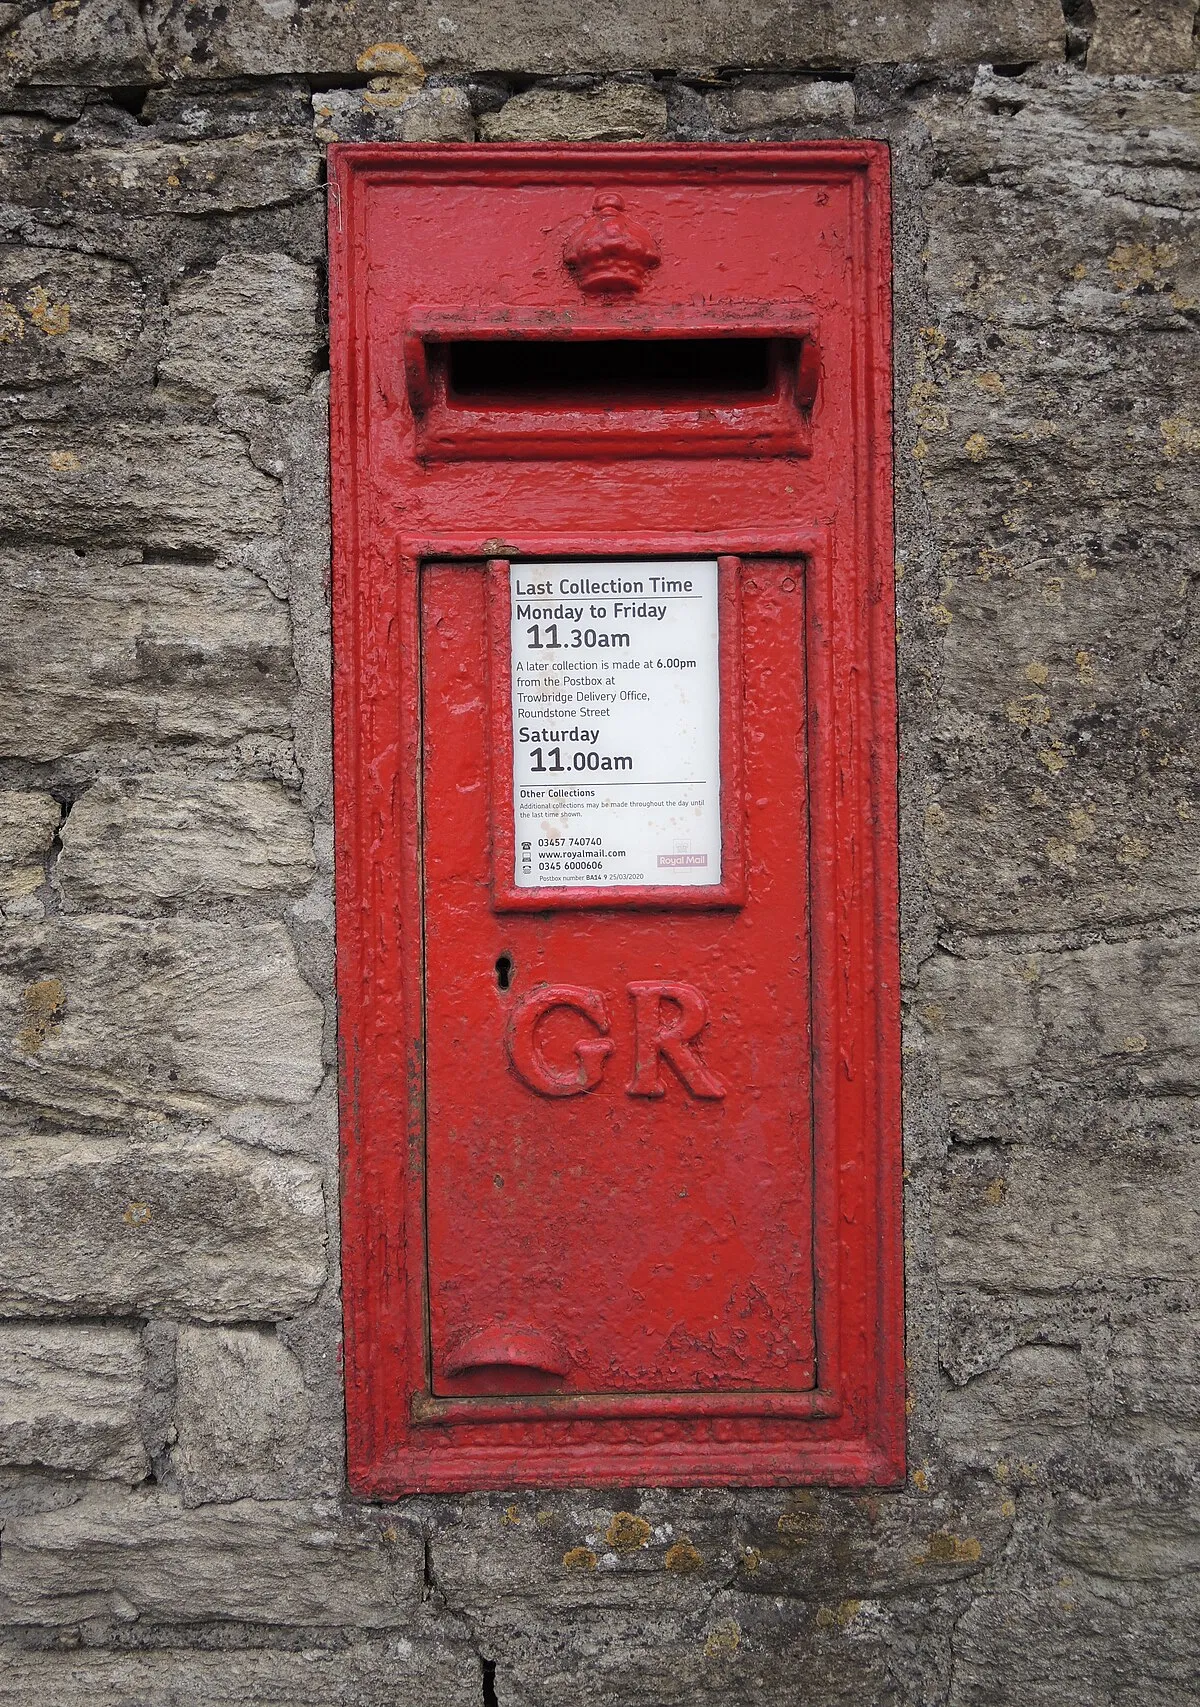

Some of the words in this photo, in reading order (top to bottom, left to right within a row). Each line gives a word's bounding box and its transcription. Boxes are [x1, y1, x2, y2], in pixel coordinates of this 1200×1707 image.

[516, 580, 553, 595] Last
[560, 579, 643, 594] Collection
[649, 577, 693, 593] Time
[517, 605, 583, 621] Monday
[590, 606, 606, 618] to
[614, 603, 666, 620] Friday
[527, 624, 630, 648] 11.30am
[517, 662, 524, 671] A
[527, 661, 549, 671] later
[552, 660, 598, 670] collection
[602, 661, 609, 670] is
[613, 659, 640, 669] made
[643, 660, 653, 669] at
[657, 659, 696, 670] 6.00pm
[517, 677, 540, 687] from
[544, 677, 560, 686] the
[563, 676, 602, 686] Postbox
[605, 677, 615, 685] at
[518, 692, 573, 704] Trowbridge
[577, 692, 616, 703] Delivery
[620, 691, 650, 702] Office,
[518, 708, 577, 718] Roundstone
[580, 707, 610, 717] Street
[519, 727, 599, 744] Saturday
[530, 747, 633, 772] 11.00am
[520, 790, 545, 798] Other
[548, 789, 595, 798] Collections
[630, 800, 664, 808] throughout
[538, 838, 565, 847] 03457
[569, 838, 602, 846] 740740
[539, 849, 626, 859] www.royalmail.com
[539, 862, 561, 870] 0345
[564, 861, 603, 870] 6000606
[660, 856, 685, 865] Royal
[687, 856, 705, 864] Mail
[504, 979, 727, 1101] GR
